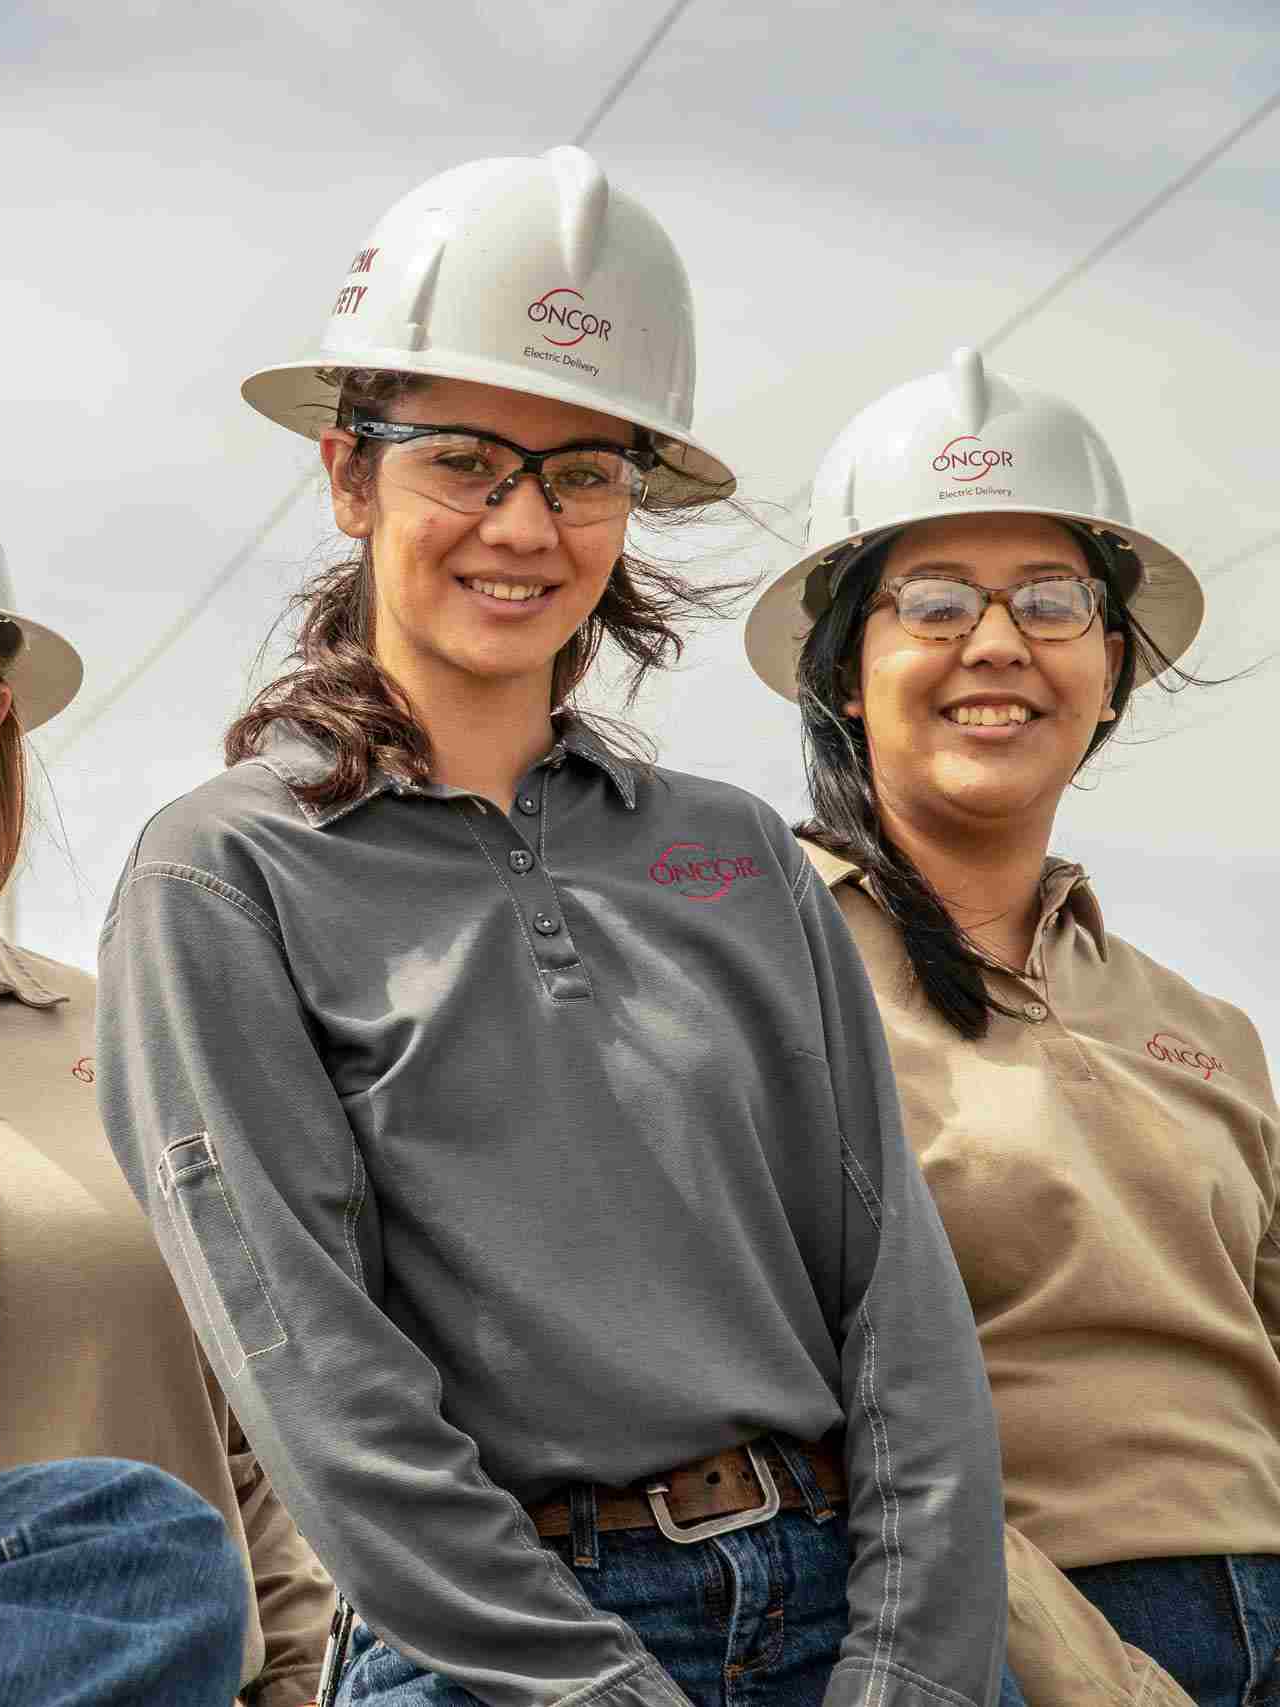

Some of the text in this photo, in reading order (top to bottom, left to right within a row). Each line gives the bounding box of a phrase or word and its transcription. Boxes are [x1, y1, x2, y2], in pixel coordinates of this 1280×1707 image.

[528, 302, 612, 341] ONCOR
[524, 346, 600, 377] Electric Delivery
[932, 450, 1014, 471] ONCOR
[939, 486, 1012, 500] Electric Delivery
